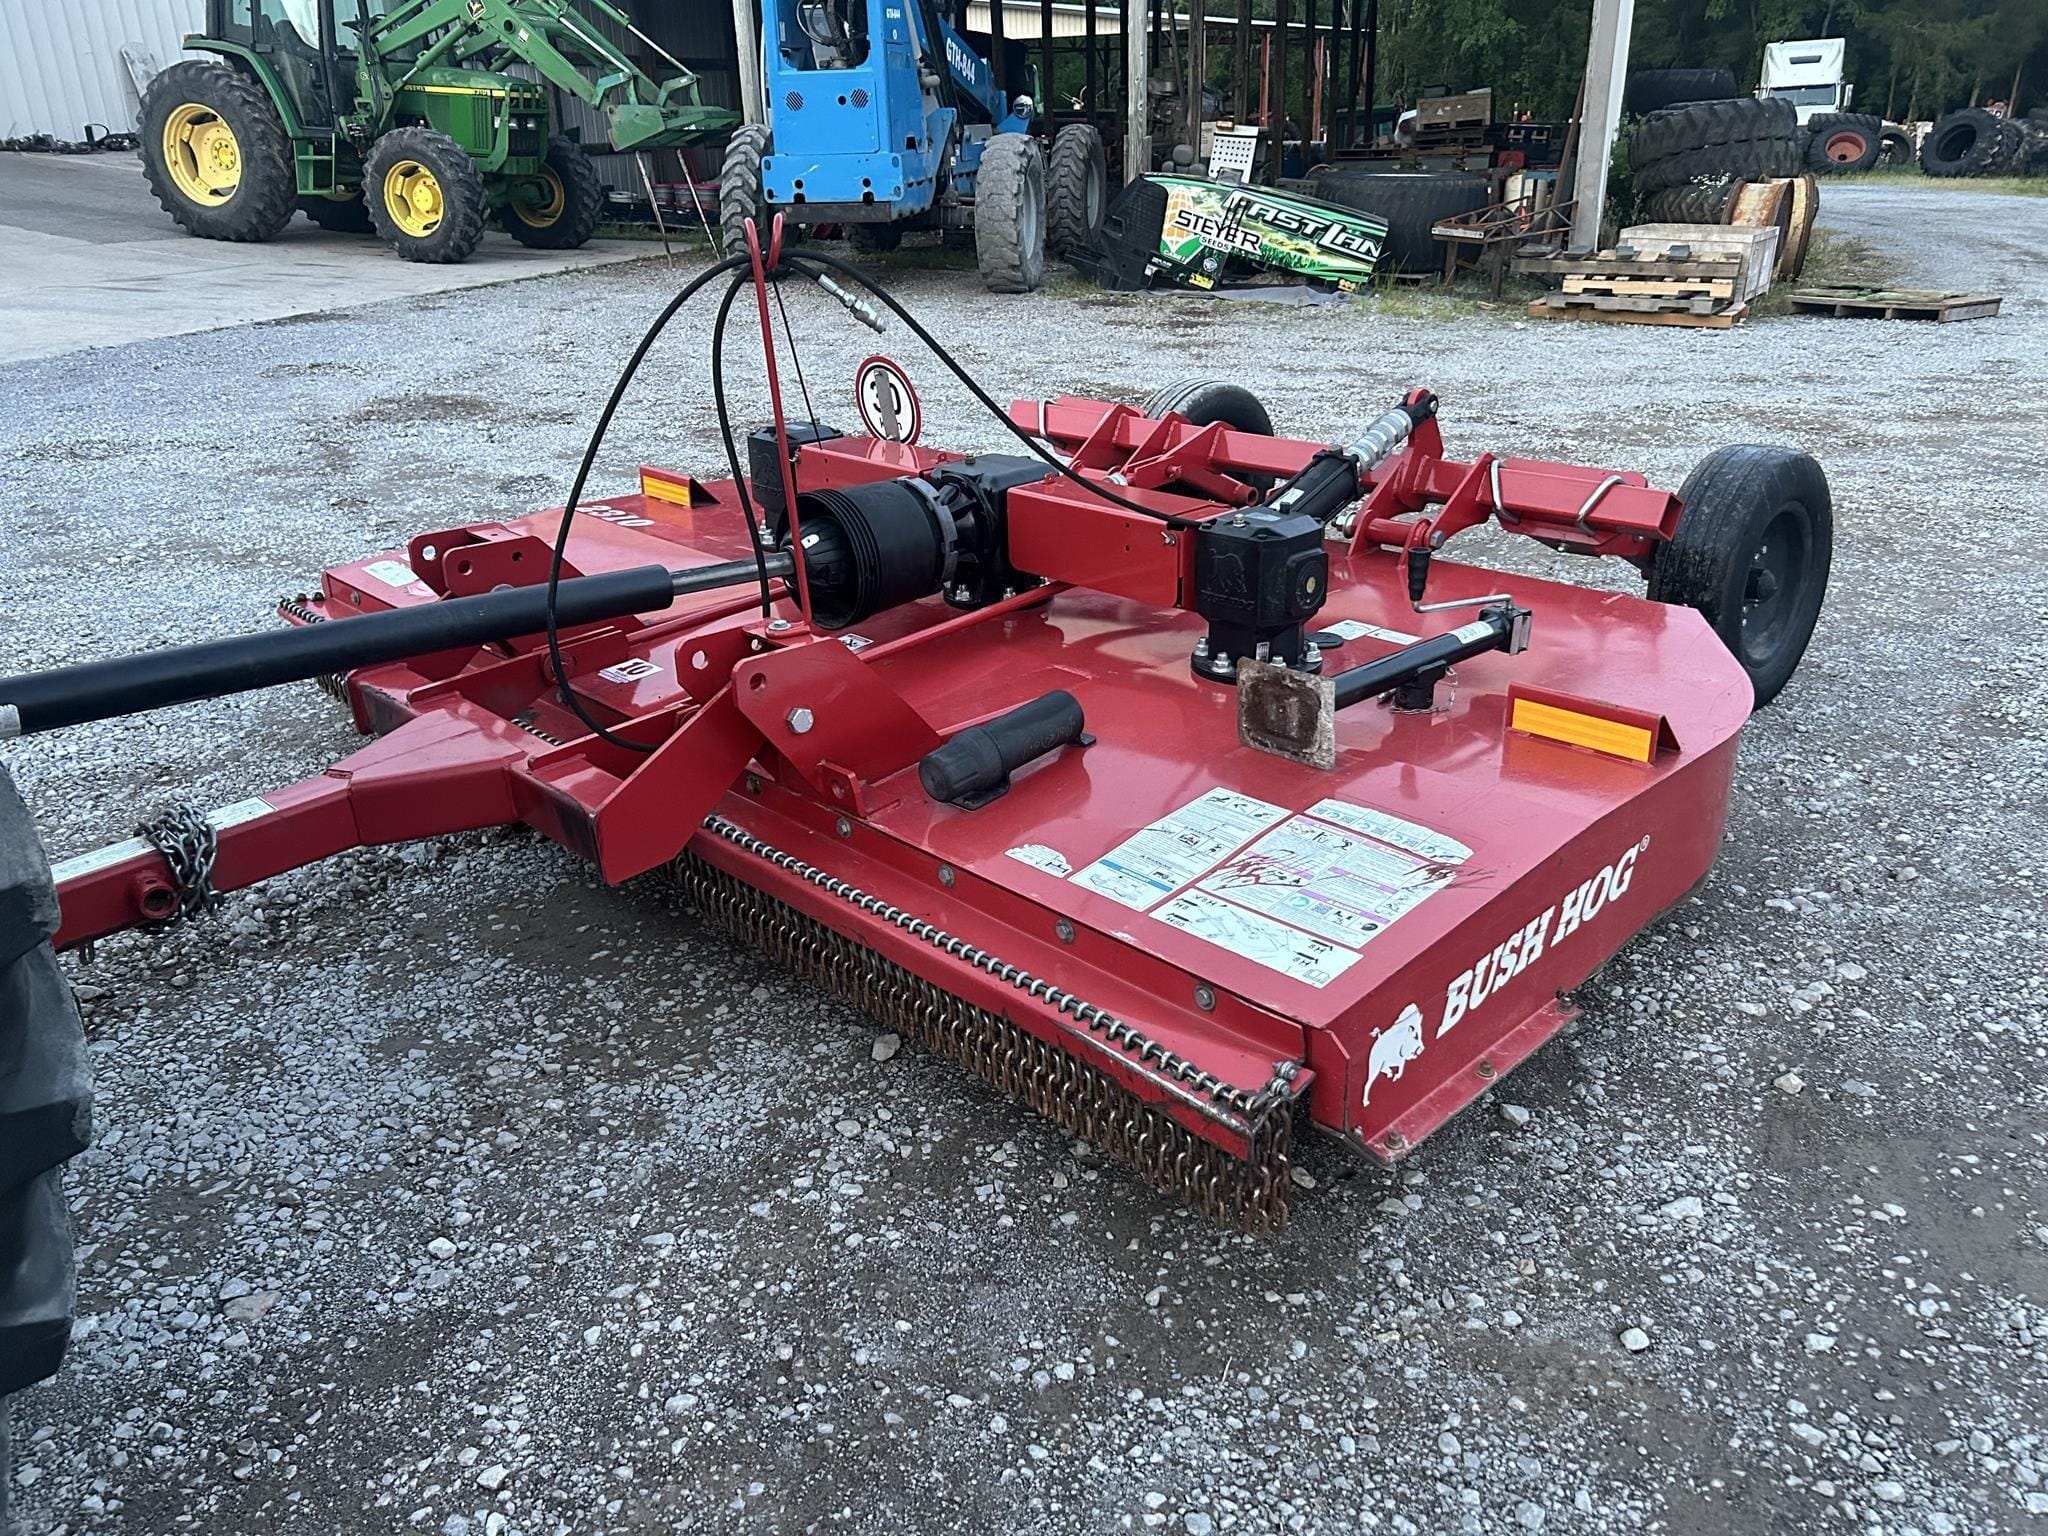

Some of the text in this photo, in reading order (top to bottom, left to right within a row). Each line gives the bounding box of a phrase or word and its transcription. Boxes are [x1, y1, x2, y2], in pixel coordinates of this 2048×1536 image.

[946, 36, 976, 86] GTH-844
[1175, 208, 1262, 255] STEYER
[1201, 236, 1230, 252] SEEDS
[574, 505, 656, 527] 2310
[616, 661, 654, 676] 10
[1435, 904, 1555, 1040] BUSH
